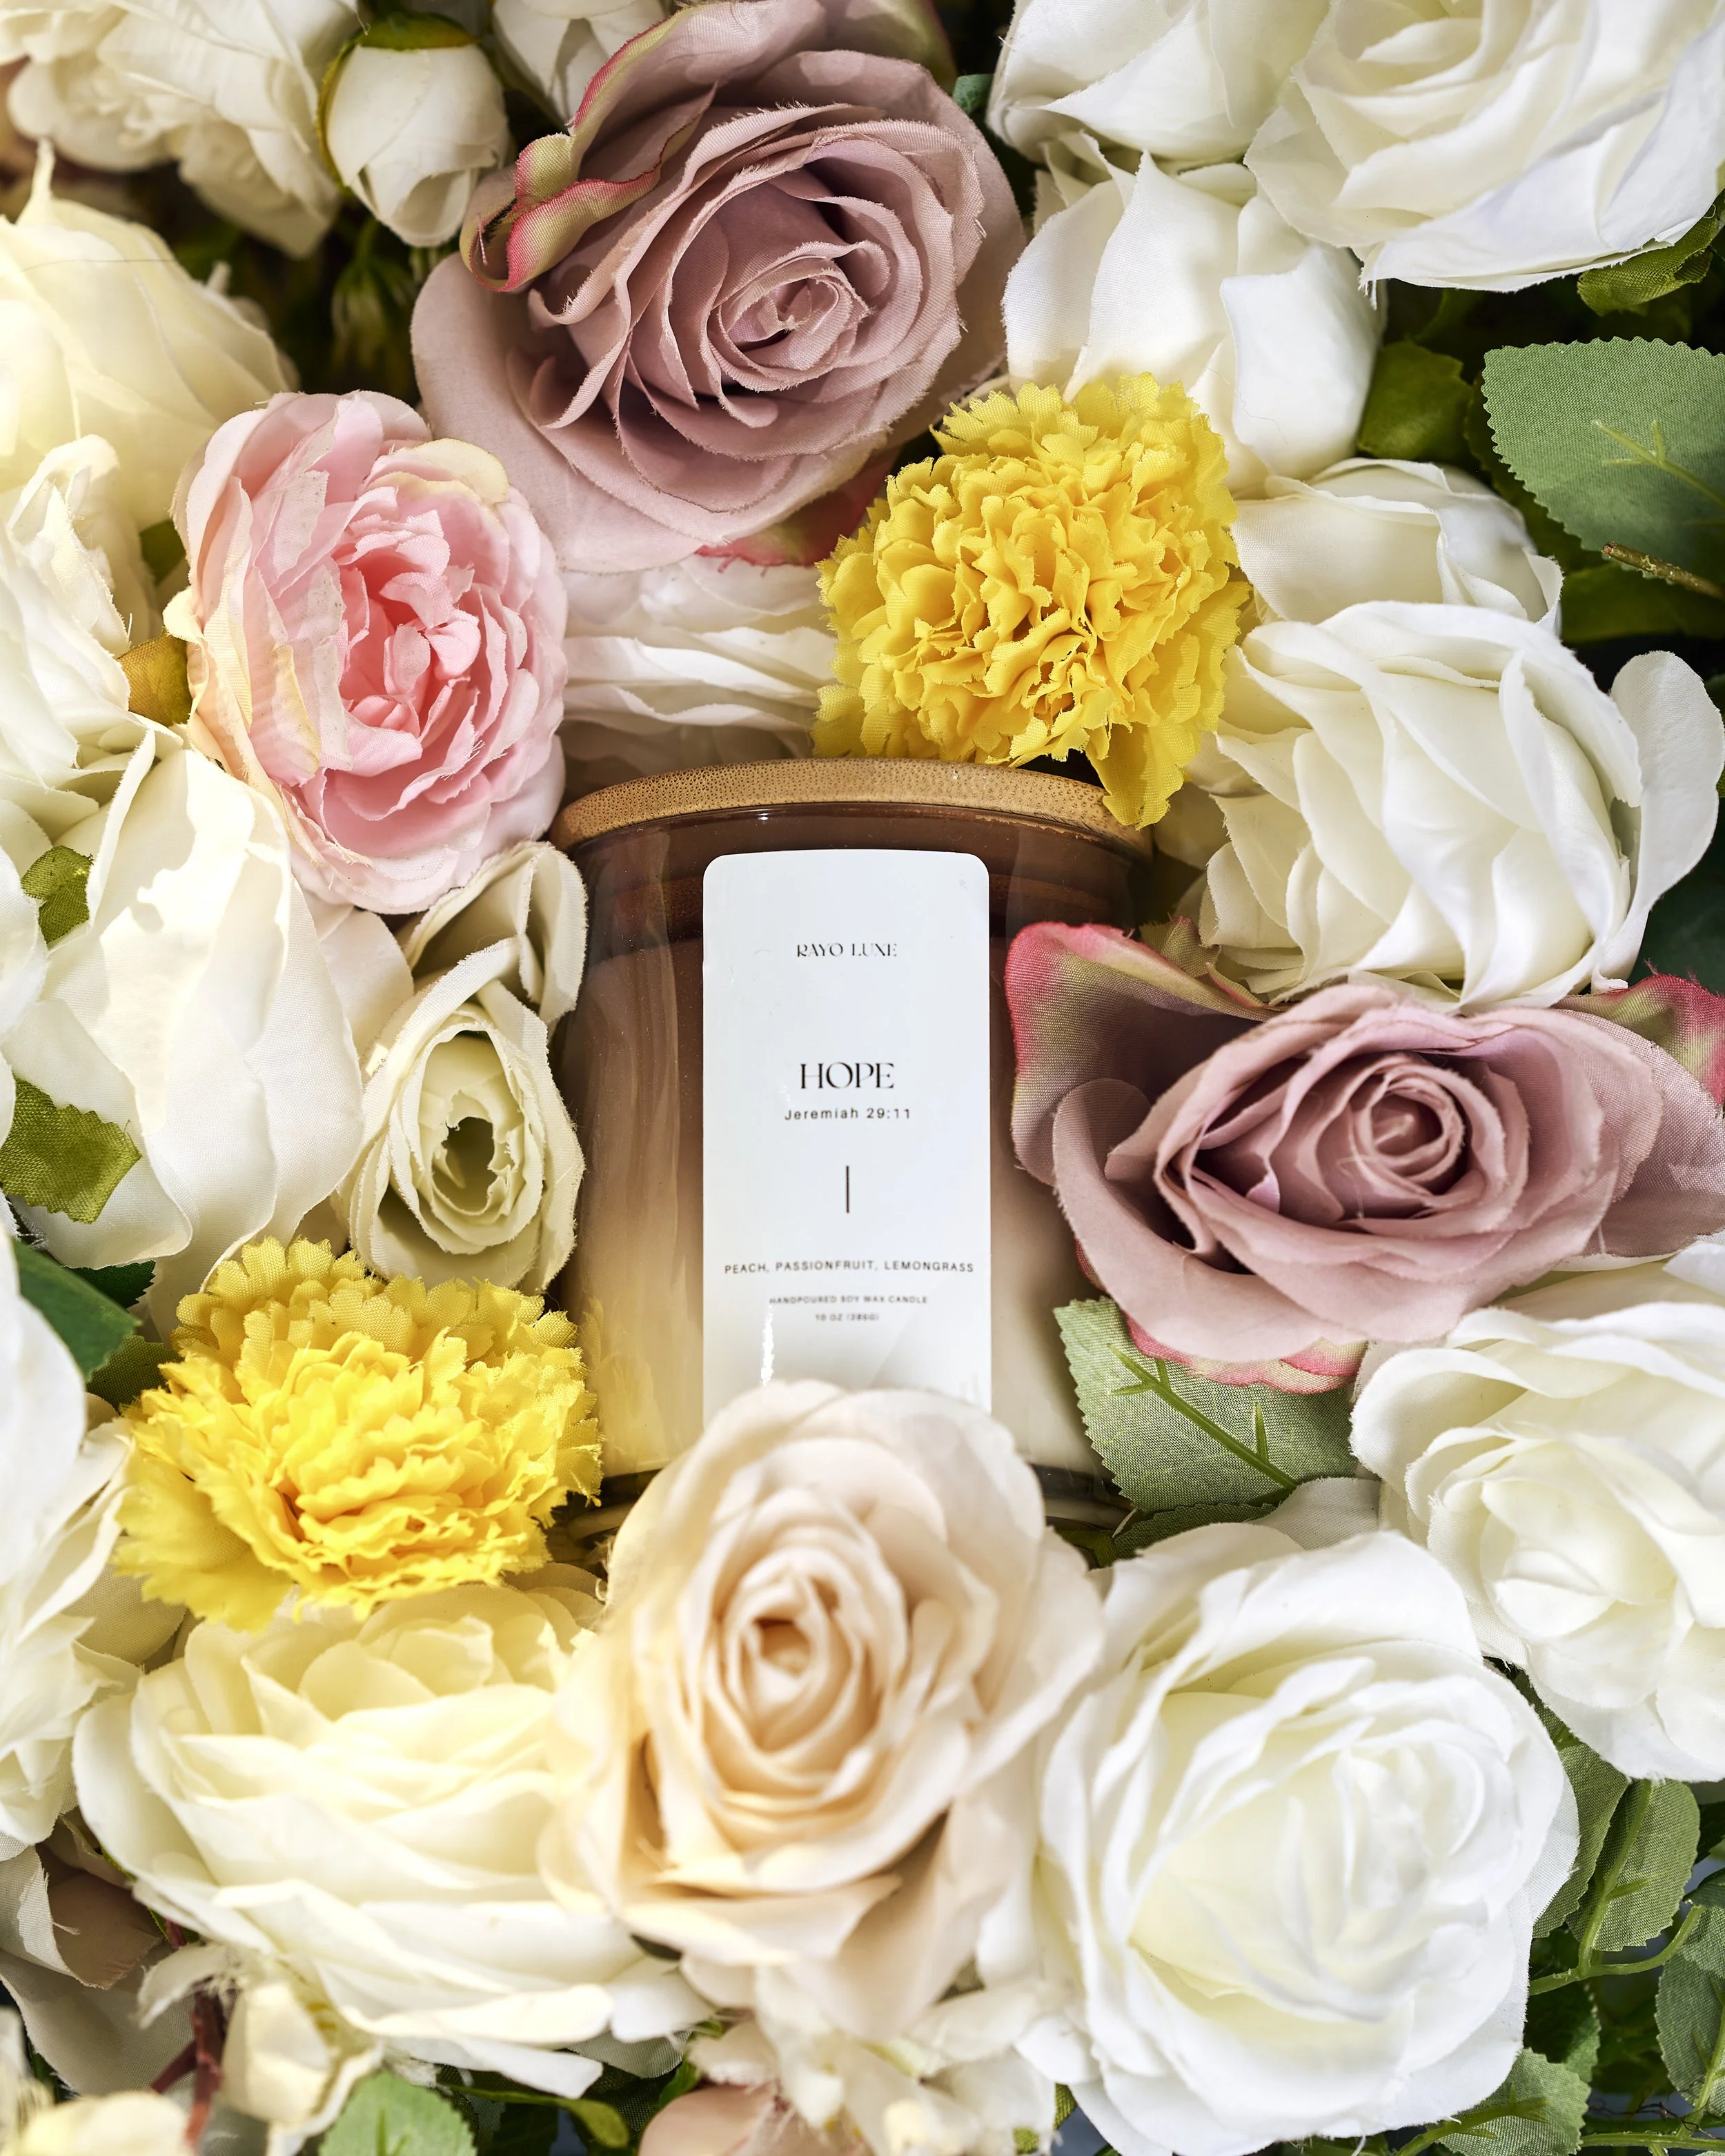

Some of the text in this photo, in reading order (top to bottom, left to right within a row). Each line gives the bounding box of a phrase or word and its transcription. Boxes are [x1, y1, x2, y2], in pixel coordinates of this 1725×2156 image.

[796, 942, 898, 958] RAYO LUXE
[800, 1061, 895, 1090] HOPE
[784, 1107, 910, 1121] Jeremiah 29:11
[724, 1260, 974, 1274] PEACH, PASSIONFRUIT, LEMONGRASS
[887, 1295, 928, 1305] CANDLE
